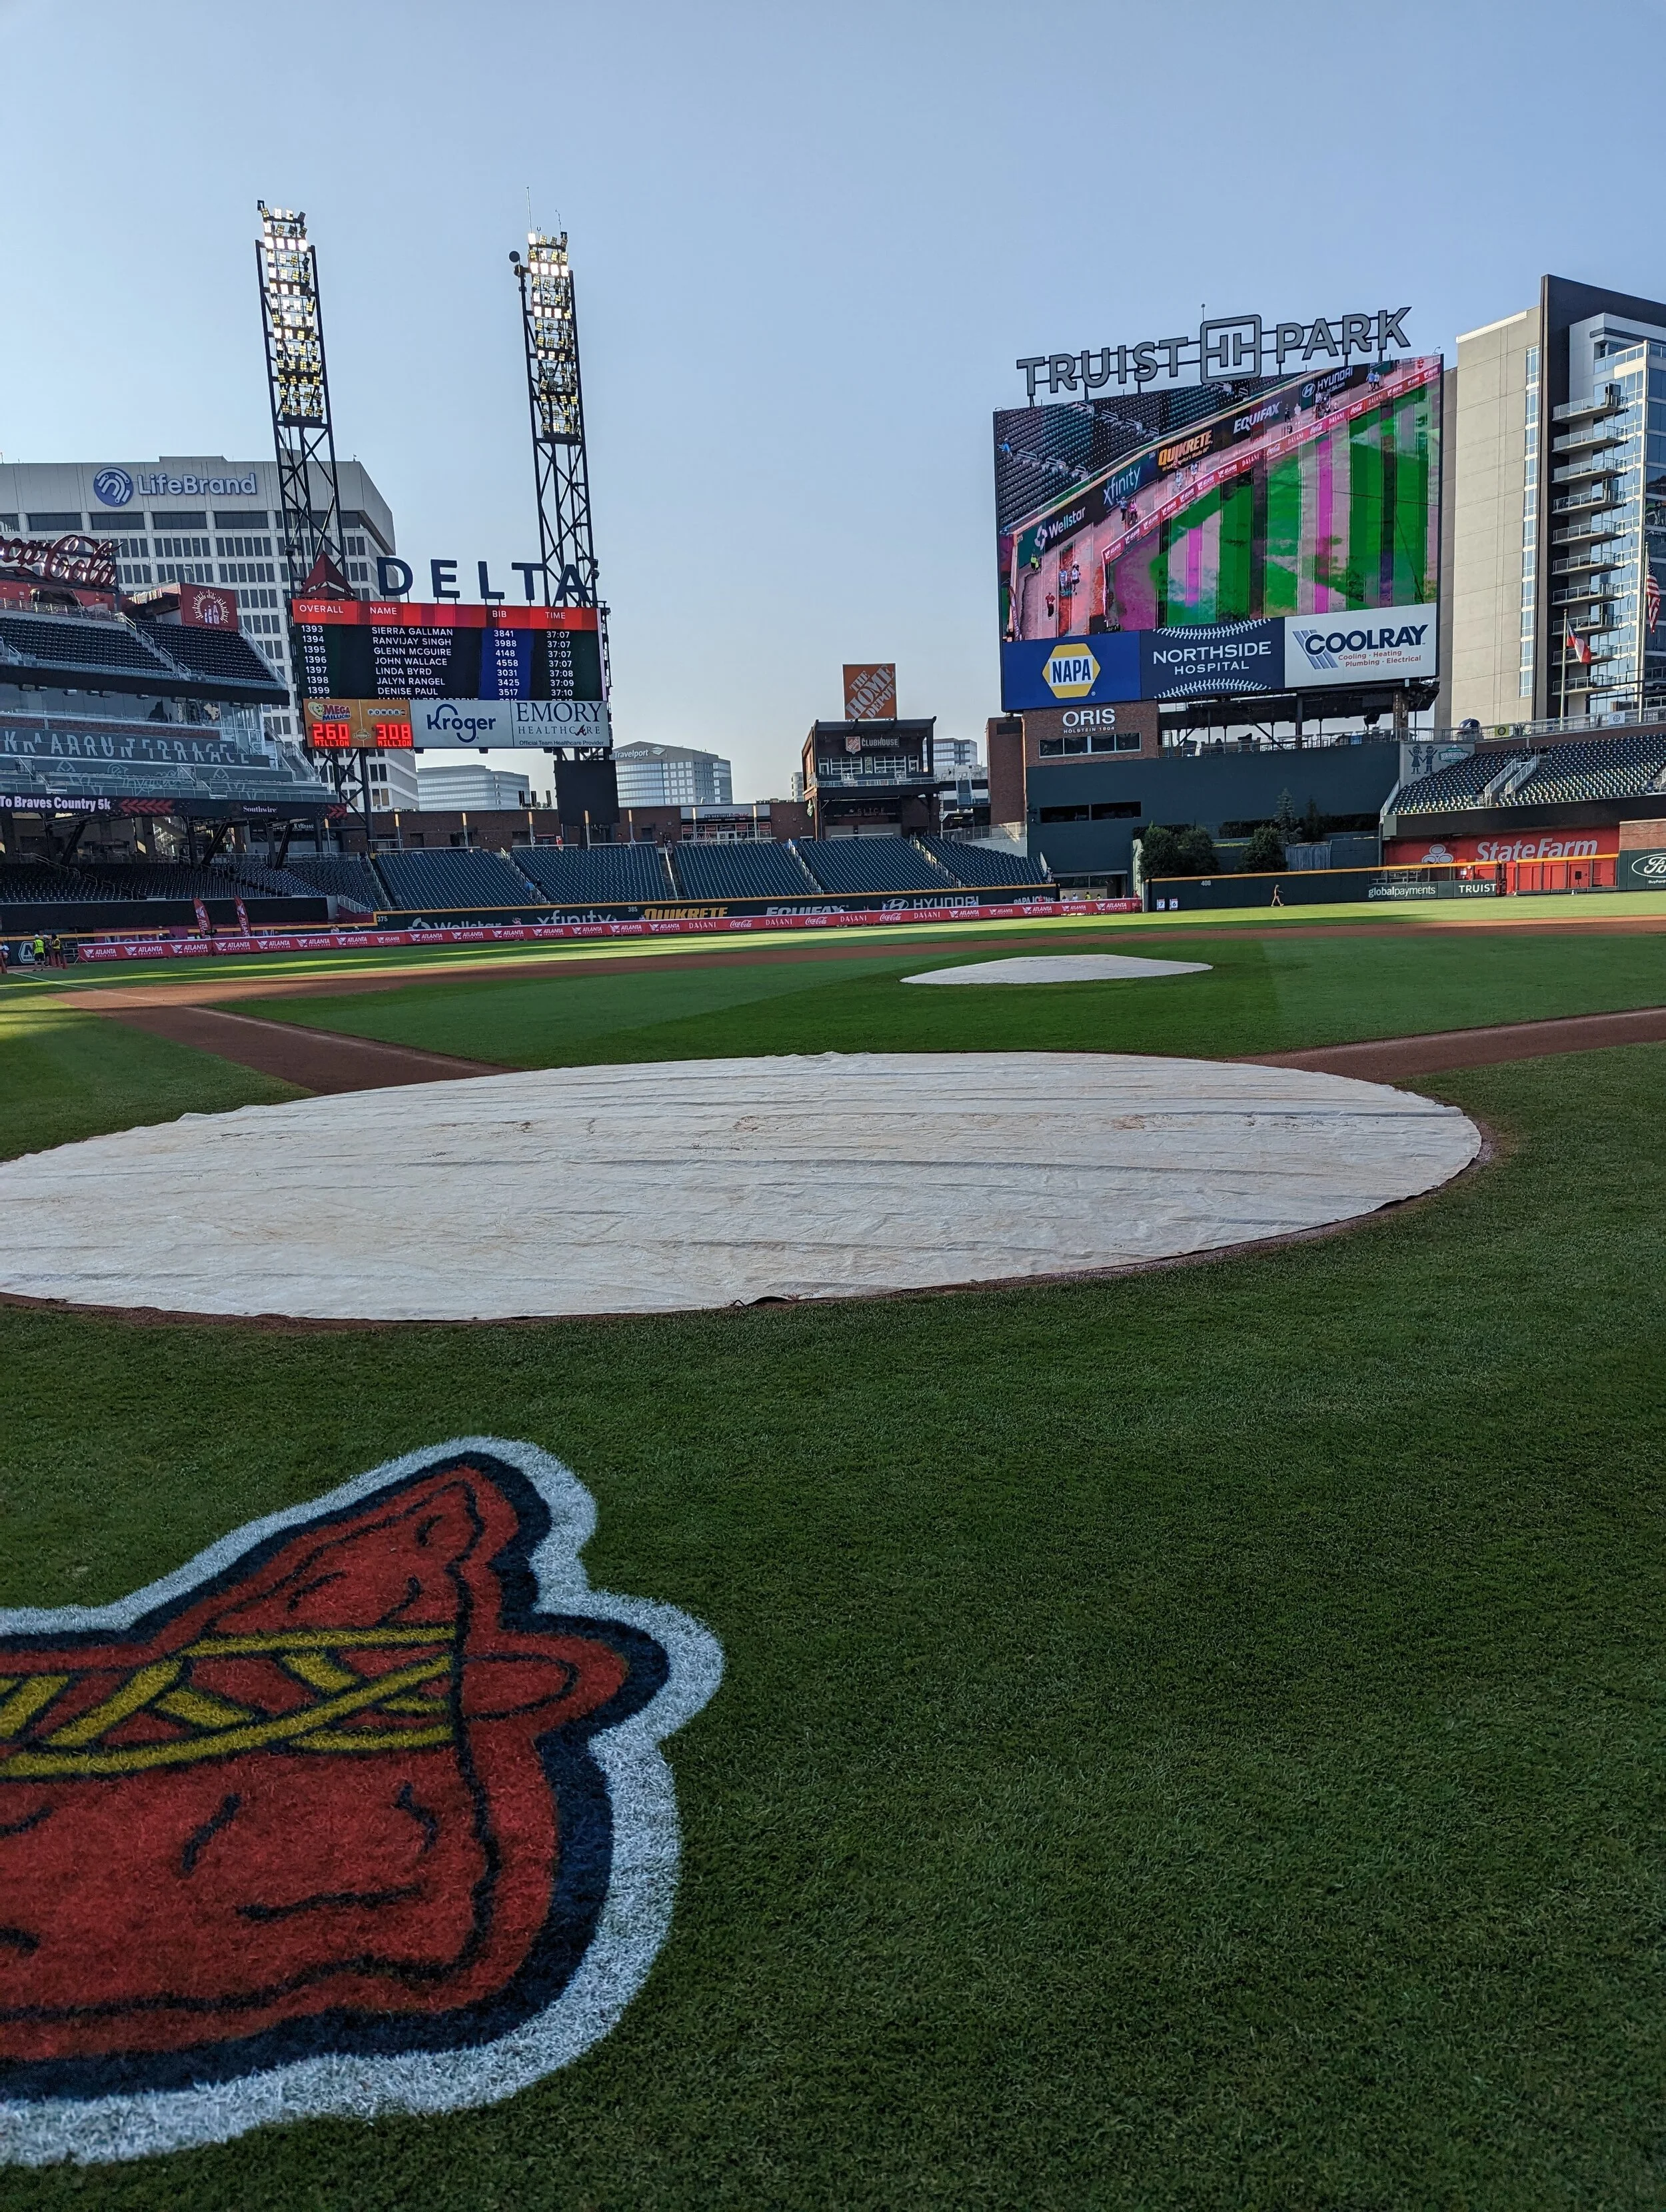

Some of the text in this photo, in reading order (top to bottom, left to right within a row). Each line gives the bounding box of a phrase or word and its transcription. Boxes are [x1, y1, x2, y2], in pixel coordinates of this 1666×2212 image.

[1016, 306, 1411, 394] TRUIST PARK
[1317, 366, 1353, 390] HYUNDAI
[1234, 401, 1280, 434] EQUIFAX
[1158, 430, 1213, 466] QUIKRETE
[137, 473, 257, 494] LifeBrand
[1104, 466, 1141, 506] xfinity
[1048, 506, 1086, 538] Wellstar
[377, 556, 592, 603] DELTA
[299, 604, 344, 614] OVERALL
[409, 628, 453, 636] GALLMAN
[1305, 624, 1429, 656] COOLRAY
[422, 638, 451, 646] SINGH
[1153, 641, 1271, 664] NORTHSIDE
[1174, 660, 1250, 675] HOSPITAL
[1345, 655, 1421, 667] Plumbing Electrical
[1052, 658, 1091, 684] NAPA
[849, 670, 870, 692] THE
[845, 664, 895, 719] HOME
[323, 704, 350, 714] MEGA
[866, 684, 896, 718] DEPOT
[516, 702, 603, 723] EMORY
[1062, 708, 1116, 727] ORIS
[426, 704, 496, 743] Kroger
[518, 726, 600, 736] HEALTHCARE
[313, 724, 349, 740] 260
[376, 724, 411, 740] 308
[862, 738, 898, 747] CLUBHOUSE
[614, 749, 649, 759] Travelport
[14, 796, 52, 808] Braves
[54, 796, 96, 812] Country
[98, 798, 111, 810] 5k
[1368, 885, 1435, 898] globalpayments
[1459, 883, 1497, 893] TRUIST
[536, 909, 612, 925] xfinity
[644, 907, 728, 920] QUIKRETE
[766, 917, 793, 926] DASANI
[840, 913, 867, 923] DASANI
[914, 910, 940, 920] DASANI
[689, 921, 716, 930] DASANI
